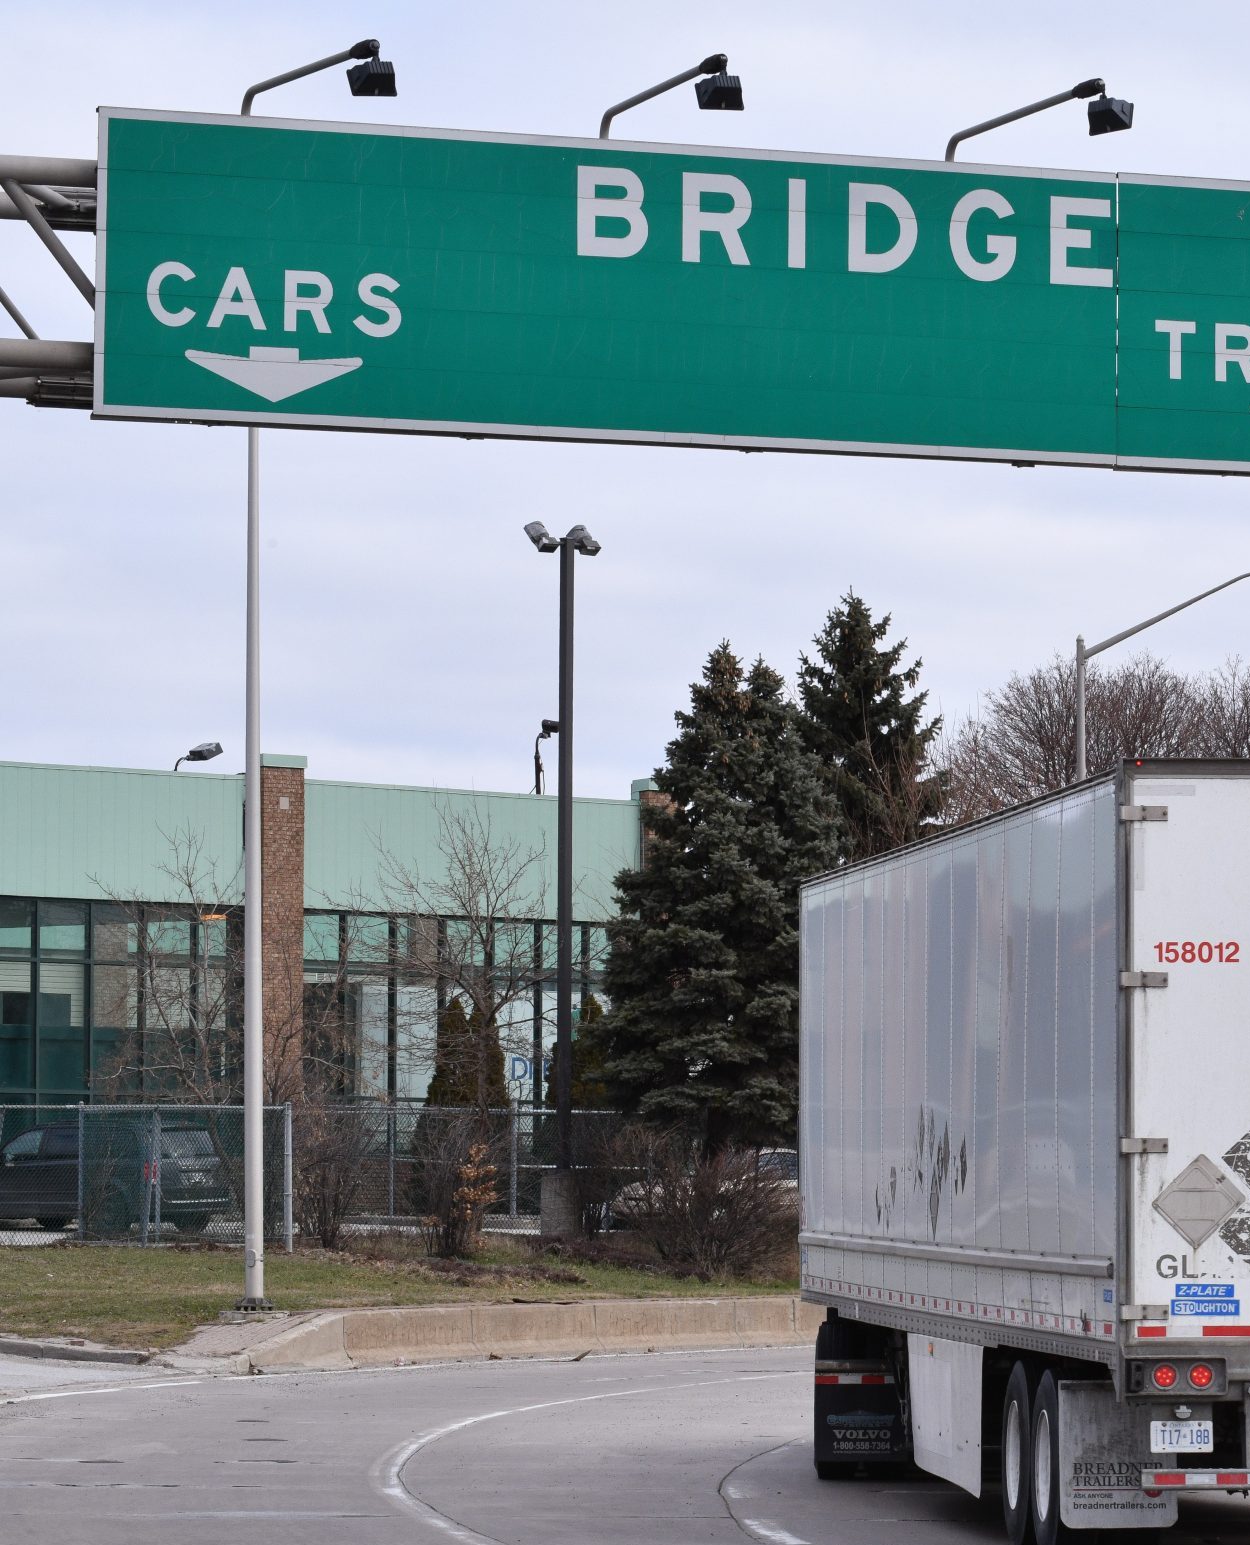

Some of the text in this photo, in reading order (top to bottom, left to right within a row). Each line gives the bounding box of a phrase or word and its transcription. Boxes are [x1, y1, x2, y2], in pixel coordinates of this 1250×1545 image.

[577, 165, 1114, 288] BRIDGE
[146, 261, 402, 338] CARS
[1154, 941, 1240, 963] 158012
[1178, 1286, 1228, 1296] Z-PLATE
[1174, 1301, 1236, 1314] STOUGHTON
[833, 1429, 891, 1439] VOLVO
[1073, 1475, 1142, 1487] TRAILERS
[1073, 1501, 1167, 1510] breadnertrailers.com
